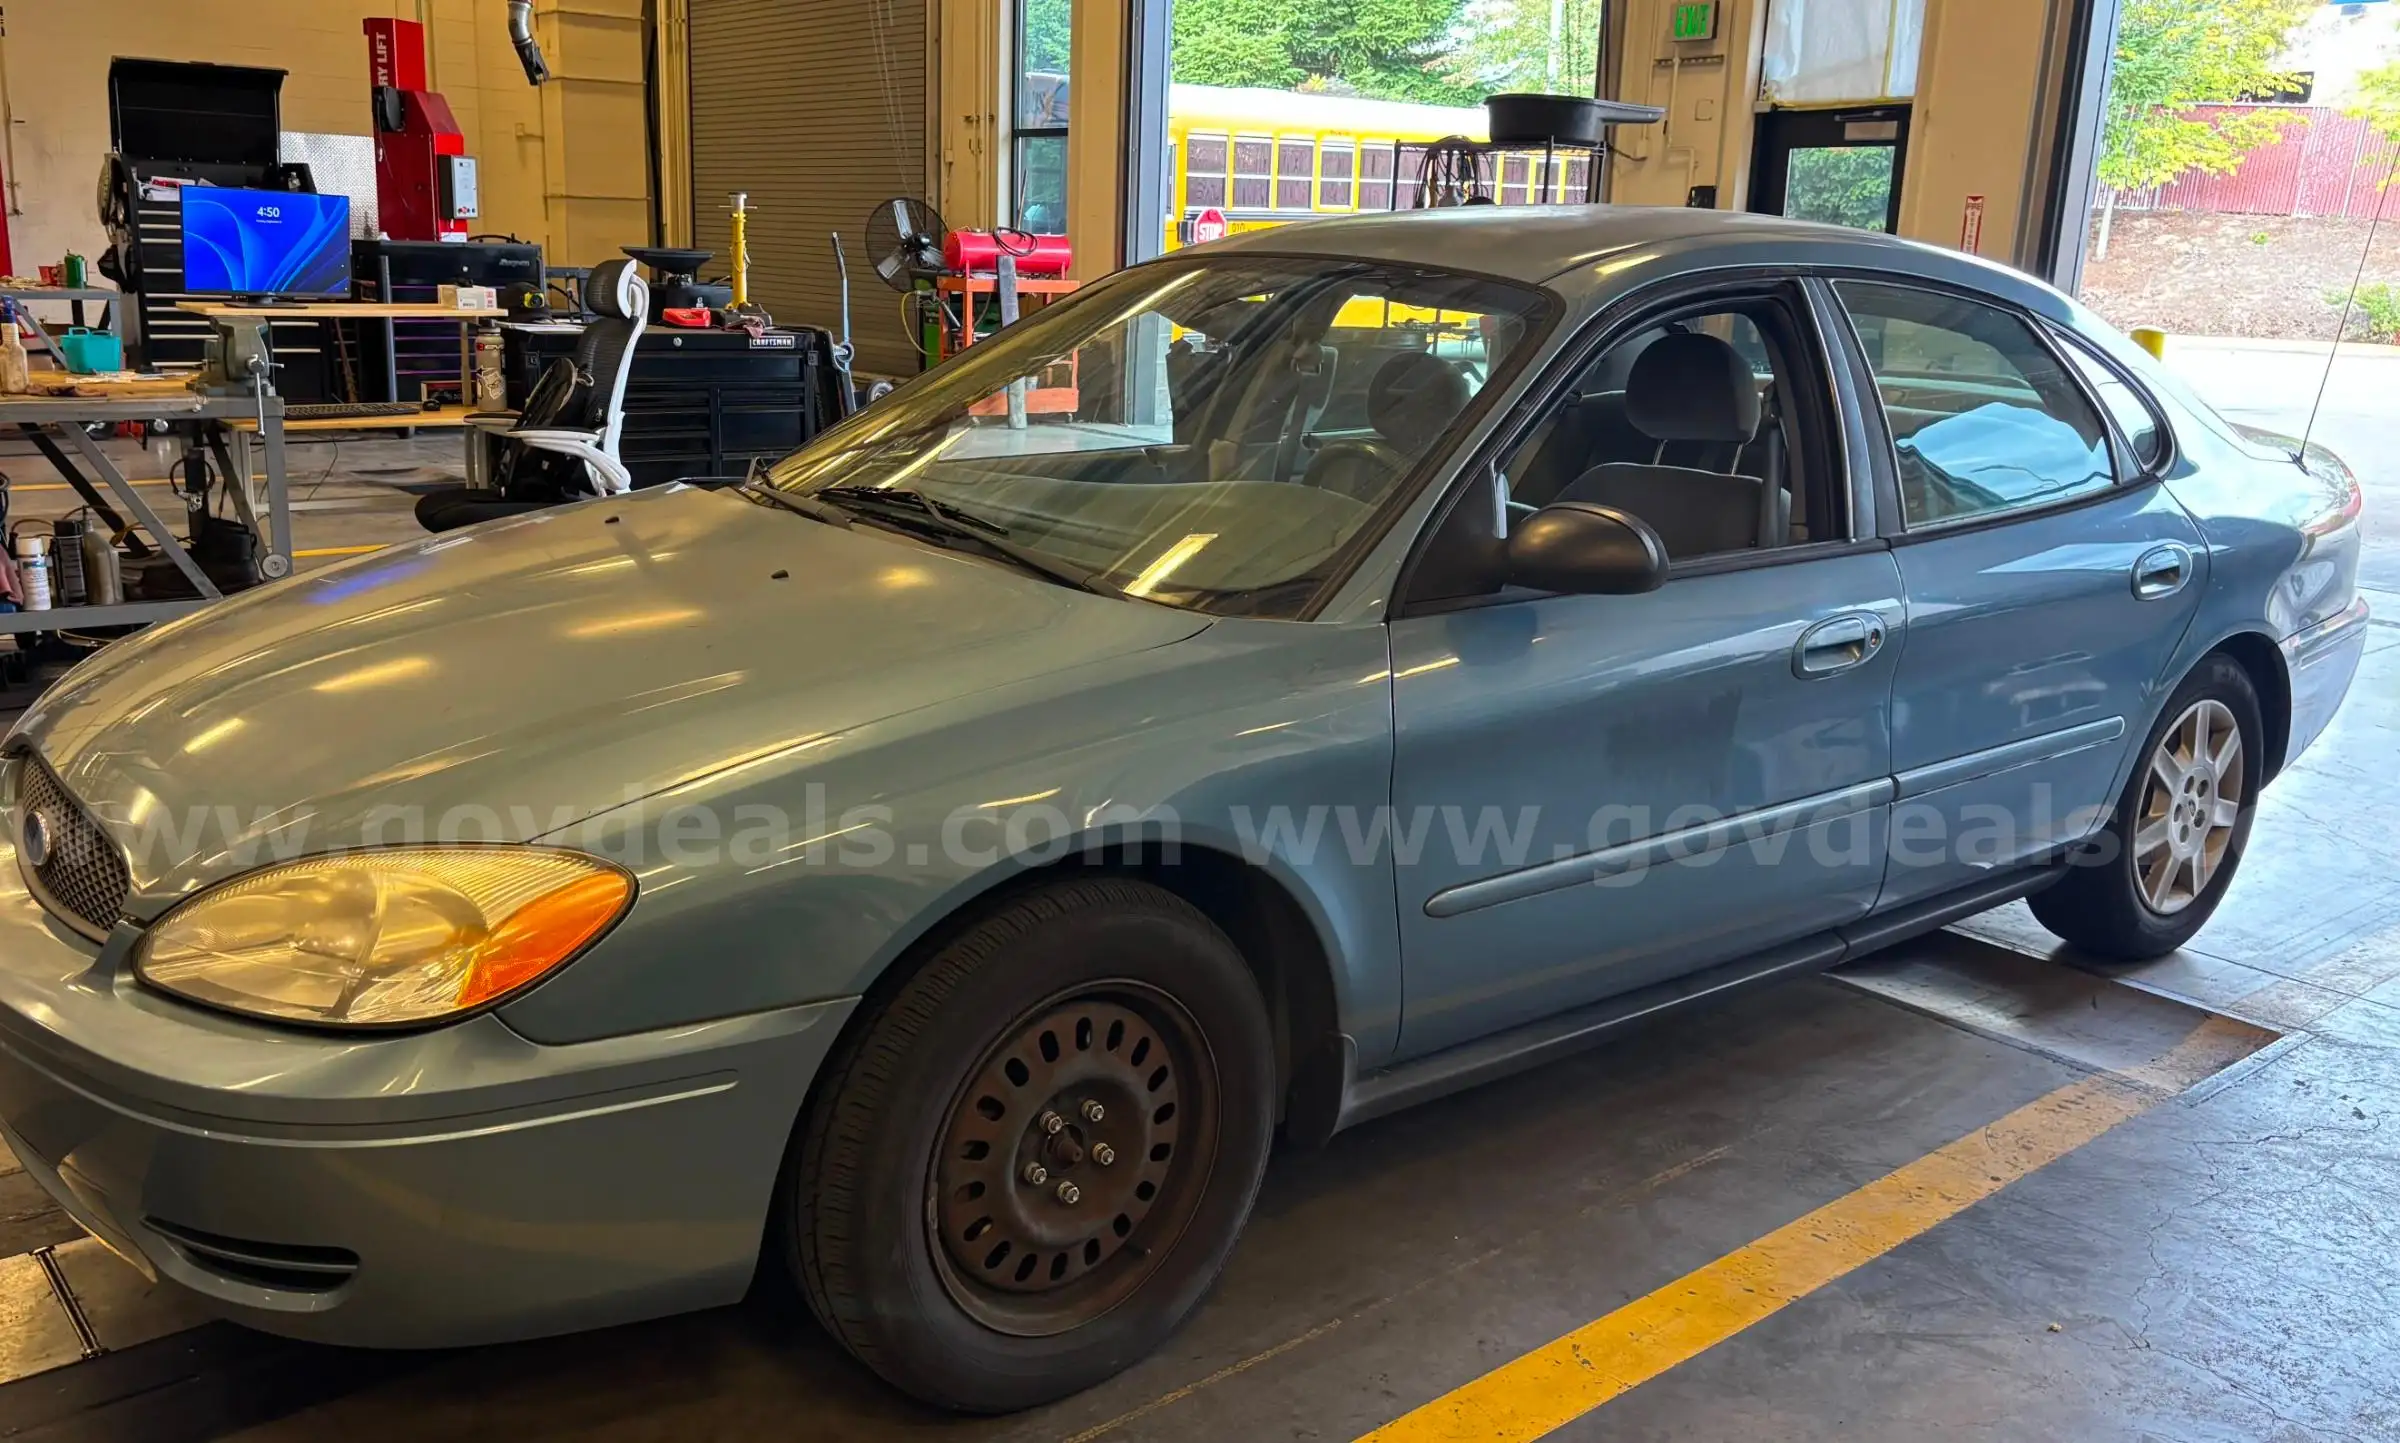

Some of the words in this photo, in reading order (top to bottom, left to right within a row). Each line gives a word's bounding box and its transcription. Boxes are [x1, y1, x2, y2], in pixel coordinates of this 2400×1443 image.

[1674, 5, 1710, 38] EXIT
[376, 32, 387, 63] LIFT
[378, 66, 388, 86] RY
[257, 206, 280, 217] 4:50
[1199, 223, 1223, 241] STOP
[752, 338, 792, 346] CRAFTSMAN
